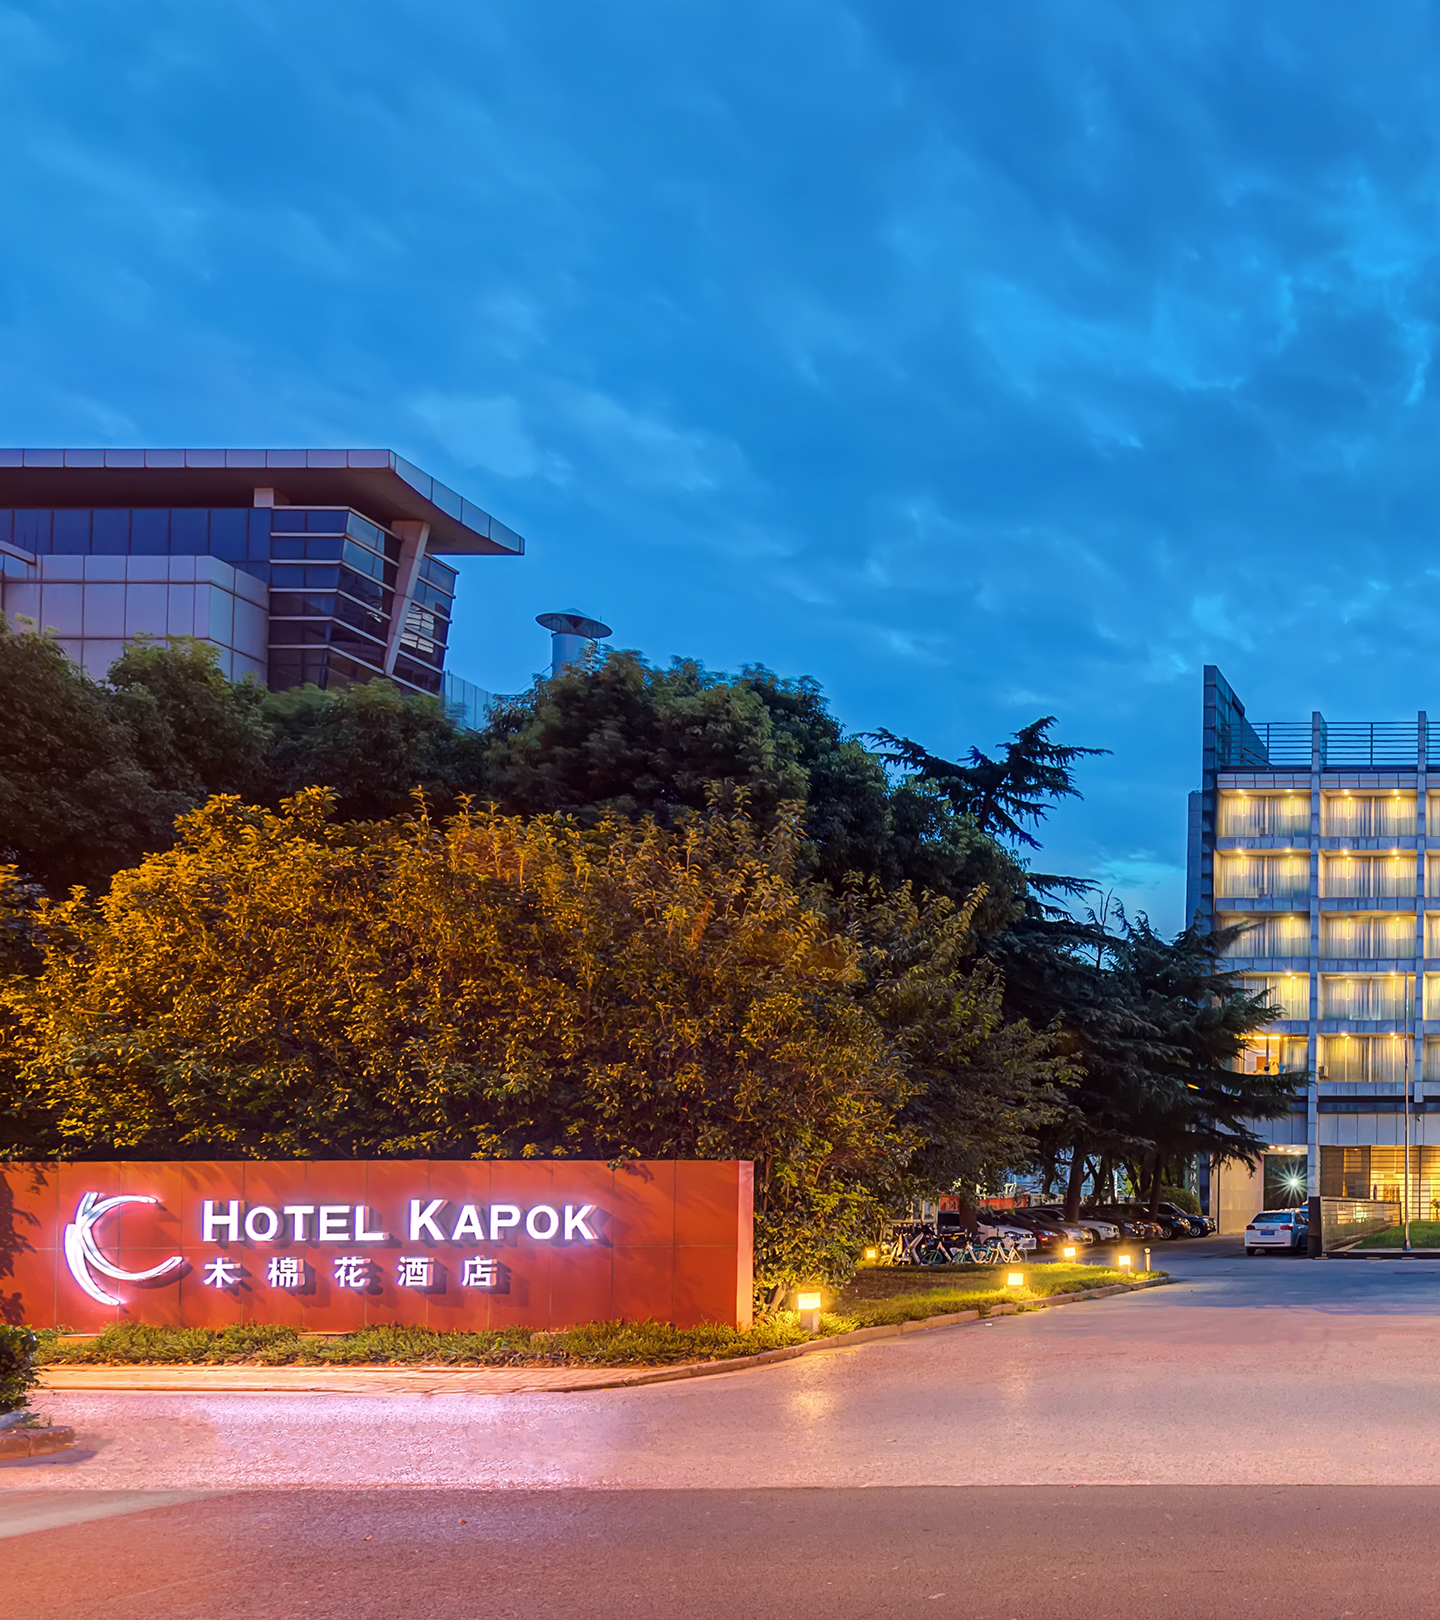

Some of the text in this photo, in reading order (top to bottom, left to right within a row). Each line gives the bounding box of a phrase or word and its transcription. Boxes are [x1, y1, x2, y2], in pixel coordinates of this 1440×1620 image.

[202, 1199, 598, 1241] HOTEL KAPOK
[203, 1255, 497, 1288] 木棉花酒店
